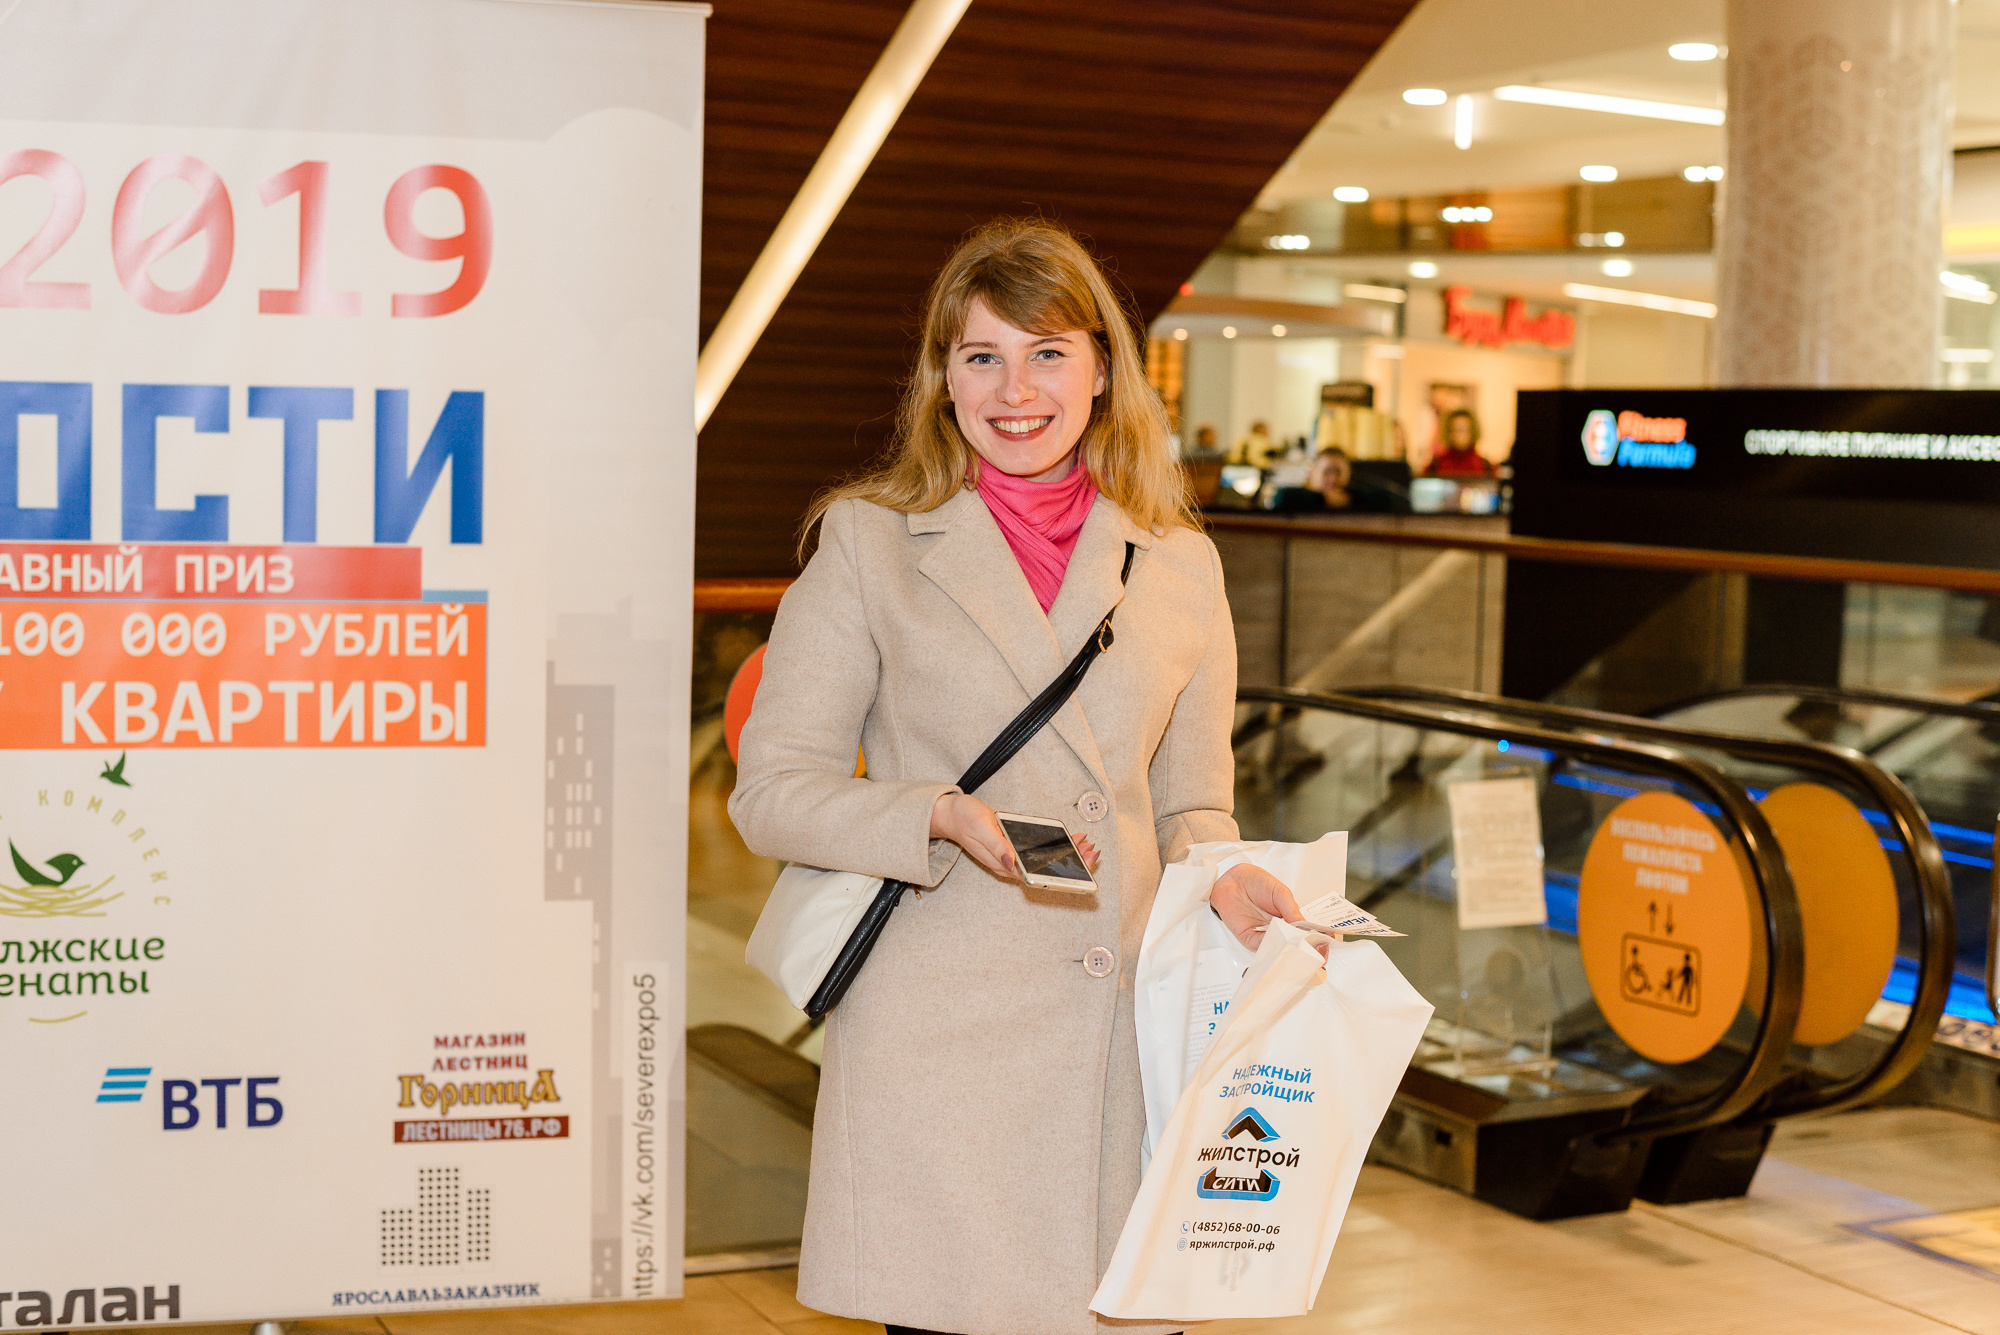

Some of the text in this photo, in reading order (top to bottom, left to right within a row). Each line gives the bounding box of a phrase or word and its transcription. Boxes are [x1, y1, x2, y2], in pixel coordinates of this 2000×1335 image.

[0, 148, 494, 318] 2019
[0, 380, 485, 545] ОСТИ
[175, 555, 295, 593] ПРИЗ
[121, 611, 227, 657] 000
[264, 604, 468, 657] РУБЛЕЙ
[61, 680, 467, 745] КВАРТИРЫ
[38, 790, 171, 906] КОМПЛЕКС
[0, 937, 165, 964] лжские
[434, 1033, 526, 1048] МАГАЗИН
[433, 1055, 528, 1071] ЛЕСТНИЦ
[1233, 1064, 1311, 1084] НАДЕЖНЫЙ
[163, 1077, 284, 1130] ВТБ
[1219, 1080, 1315, 1103] ЗАСТРОЙЩИК
[1212, 1177, 1261, 1191] СИТИ
[1192, 1221, 1281, 1235] (4852)68-00-06
[1189, 1239, 1275, 1252] яржилстрой.рф
[332, 1283, 540, 1306] ЯРОСЛАВЛЬЗАКАЗЧИК
